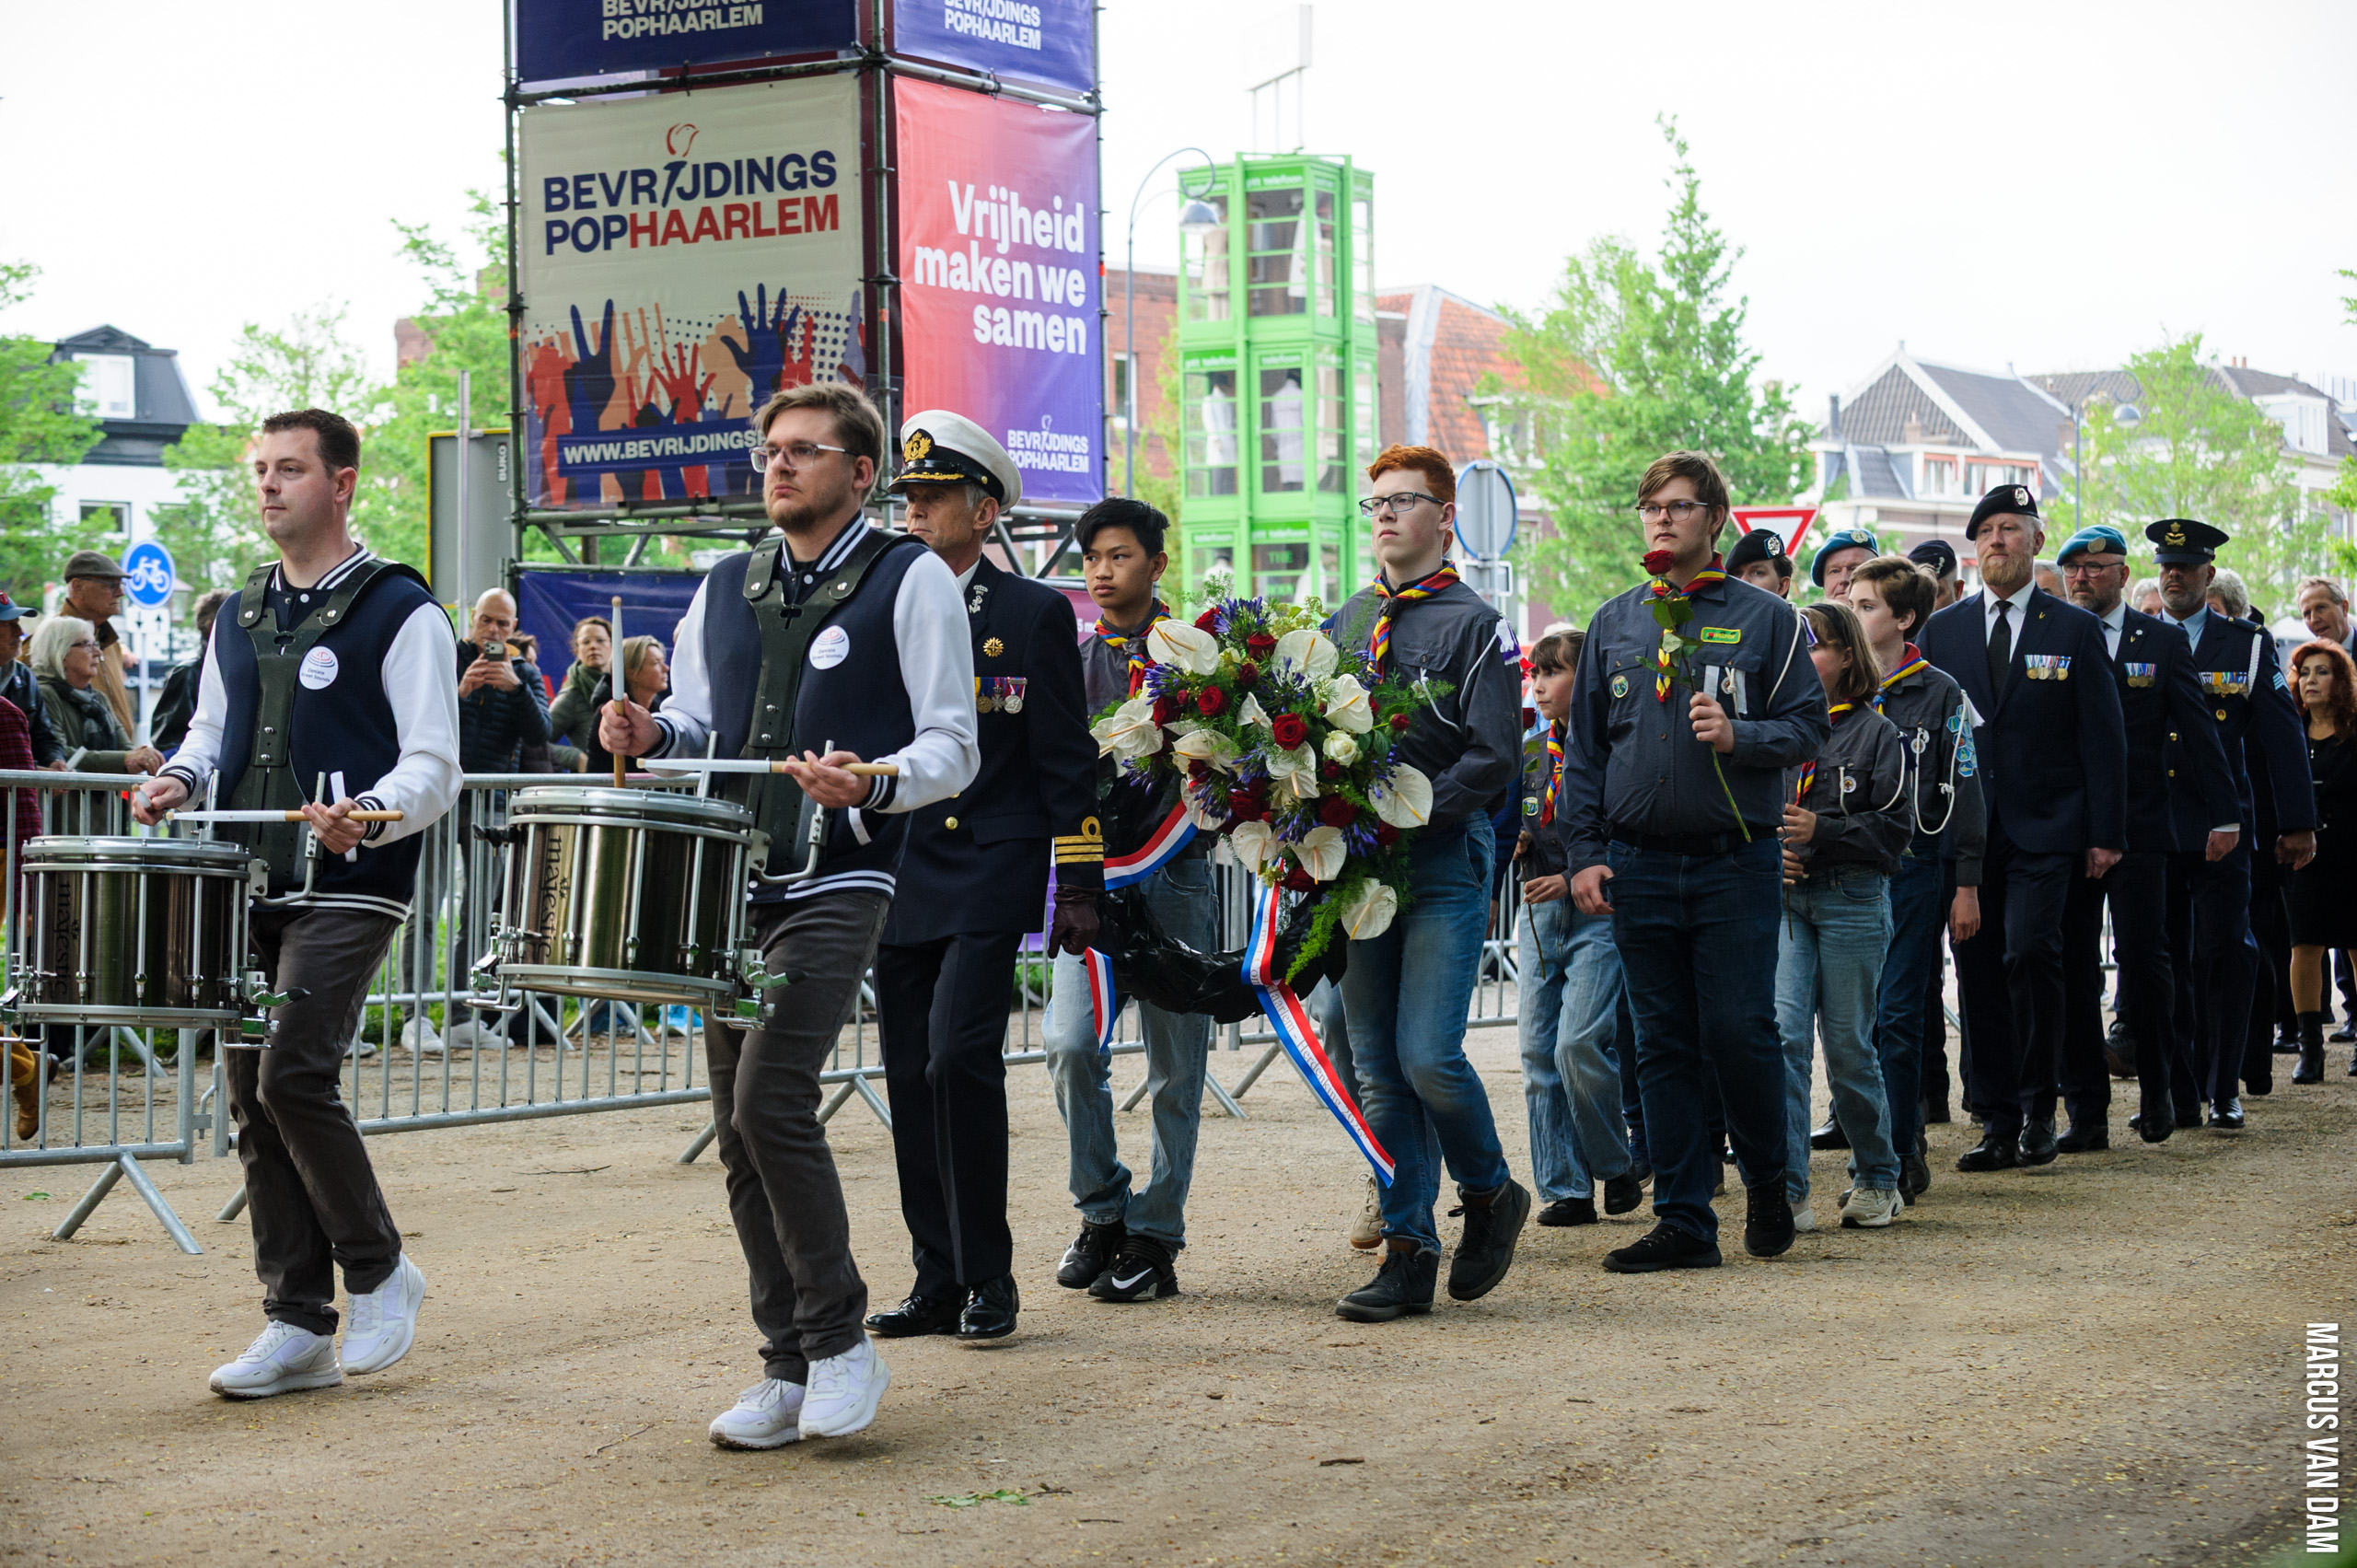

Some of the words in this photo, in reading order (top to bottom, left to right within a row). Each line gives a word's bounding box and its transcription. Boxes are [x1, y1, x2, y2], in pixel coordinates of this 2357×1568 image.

[602, 4, 763, 41] POPHAARLEM
[944, 7, 1041, 51] POPHAARLEM
[543, 150, 837, 214] BEVRIJDINGS
[545, 193, 839, 256] POPHAARLEM
[947, 180, 1085, 255] Vrijheid
[914, 239, 1034, 300] maken
[1037, 263, 1086, 308] we
[972, 304, 1086, 355] samen
[497, 445, 507, 482] BUKO
[1007, 429, 1089, 455] BEVRIJDINGS
[1007, 448, 1090, 473] POPHAARLEM
[538, 835, 562, 958] majestic
[52, 880, 71, 995] majestic
[1296, 1040, 1341, 1109] Herdenking
